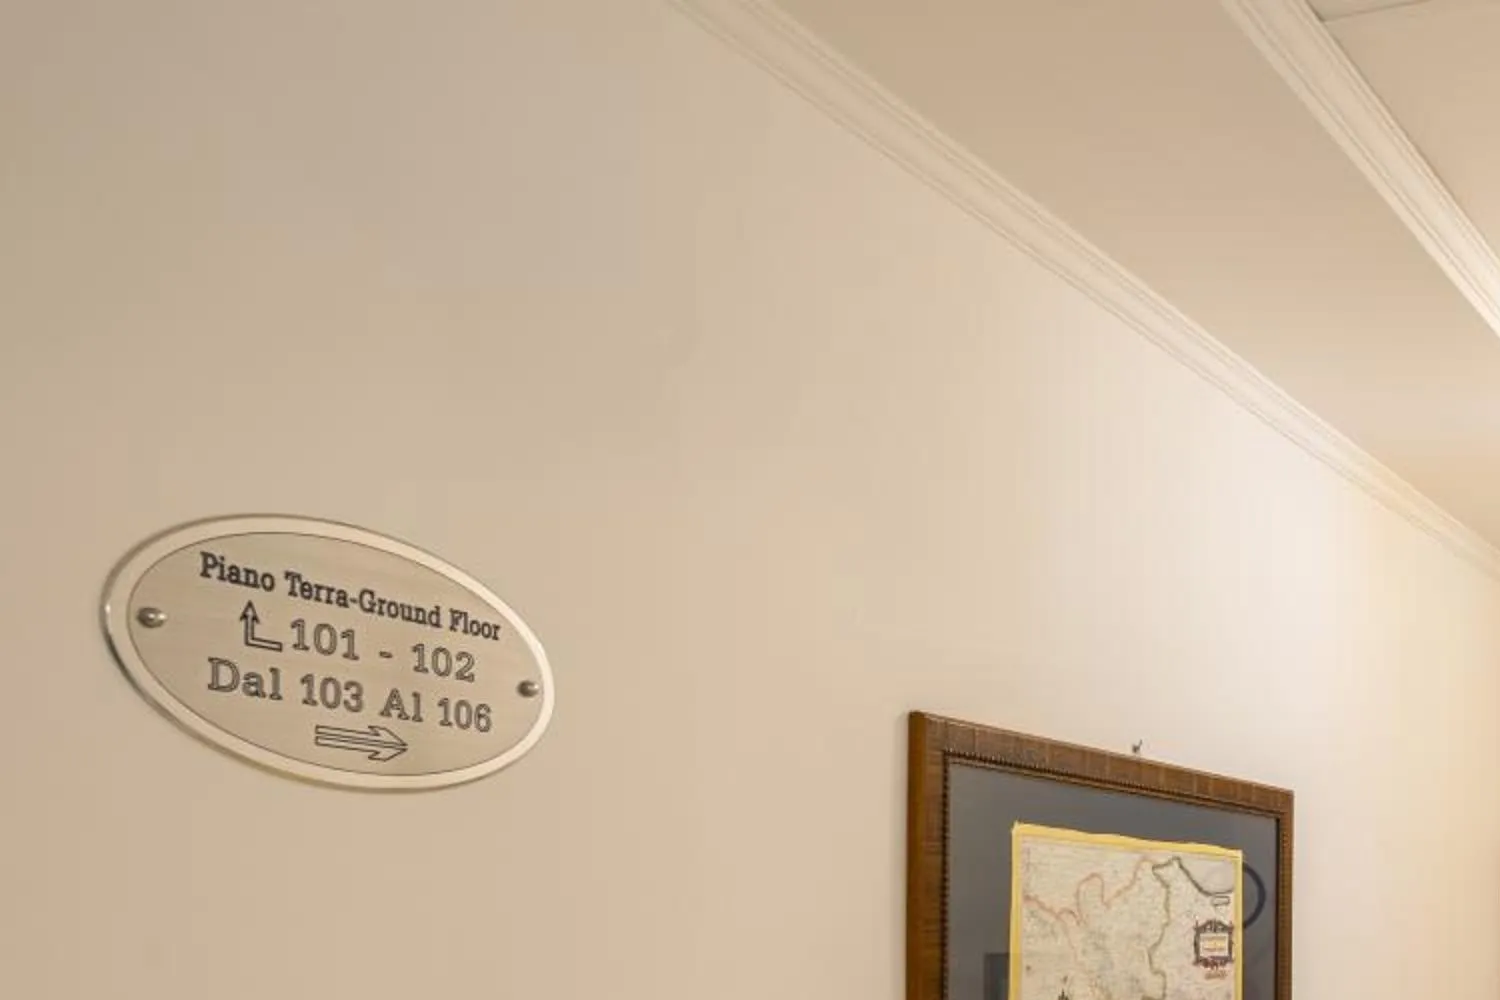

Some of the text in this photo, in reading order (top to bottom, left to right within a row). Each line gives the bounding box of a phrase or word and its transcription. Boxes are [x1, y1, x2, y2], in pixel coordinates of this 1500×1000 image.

[199, 551, 501, 642] Piano Terra-Ground Floor
[290, 618, 359, 661] 101
[411, 643, 476, 683] 102
[207, 657, 492, 733] Dal 103 Al 106
